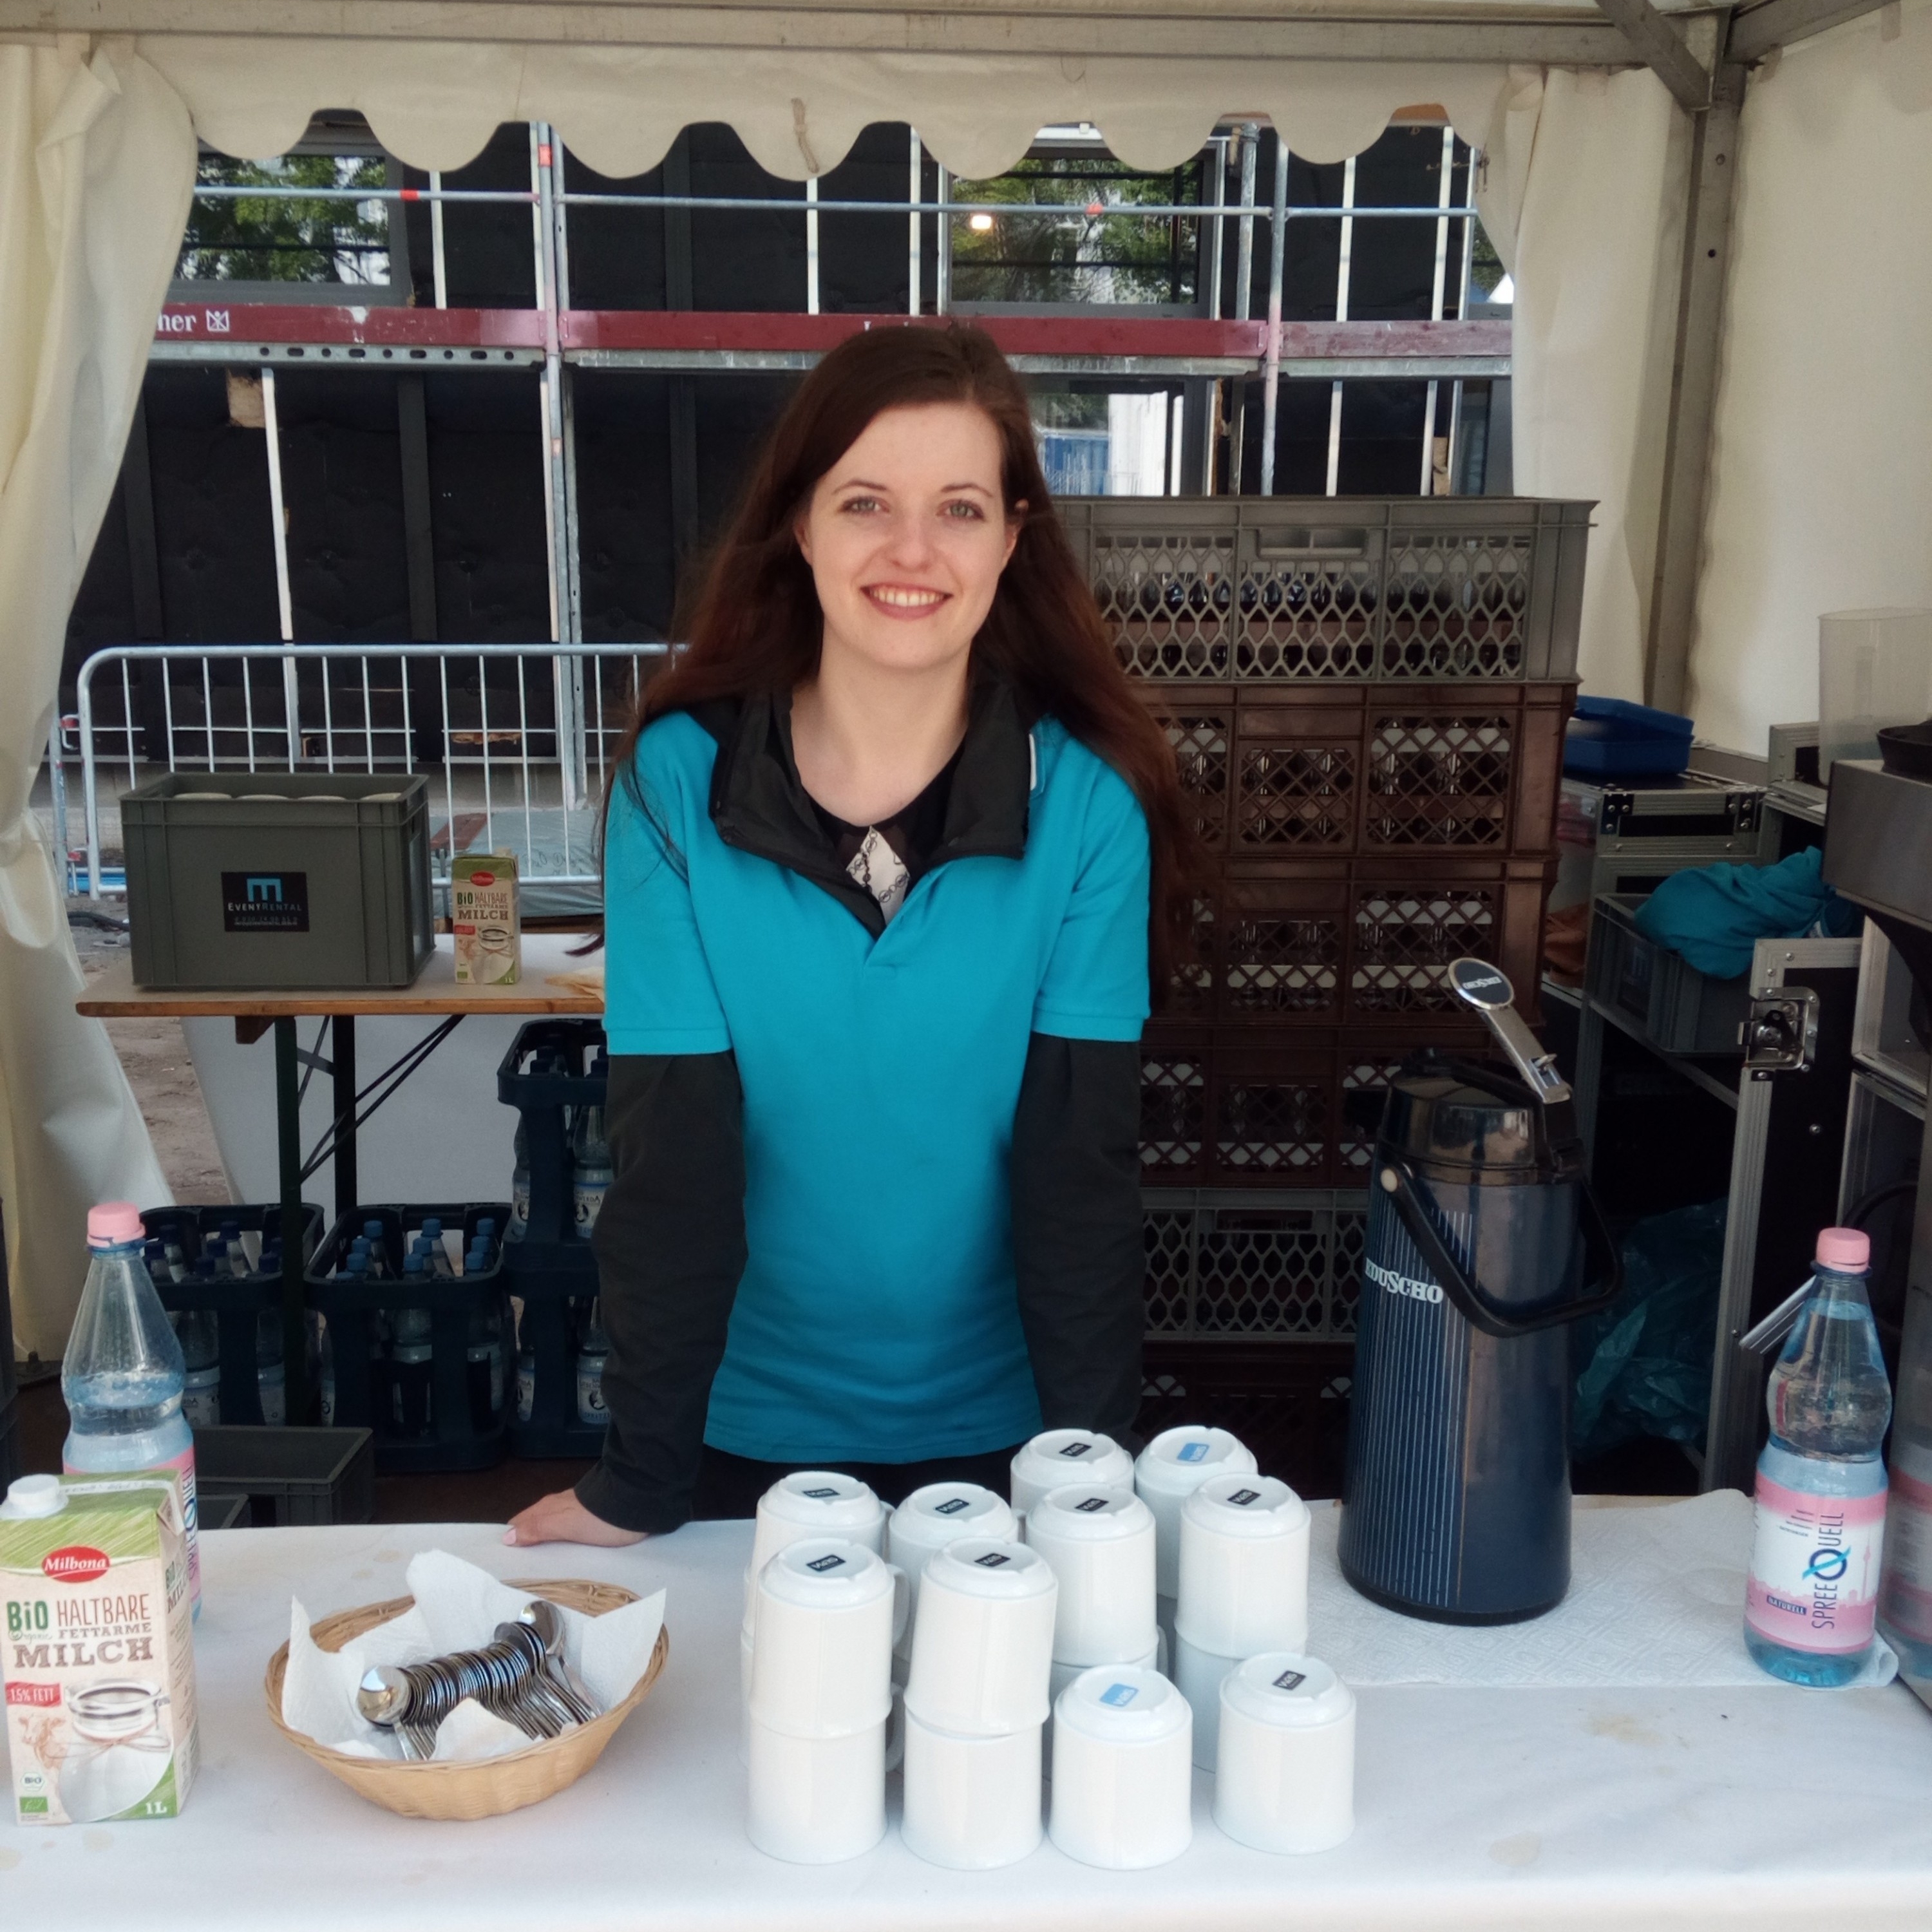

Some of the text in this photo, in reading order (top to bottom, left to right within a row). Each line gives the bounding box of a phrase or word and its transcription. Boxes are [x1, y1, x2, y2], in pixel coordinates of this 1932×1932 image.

[458, 909, 508, 920] MILCH
[44, 1556, 106, 1571] Milbona
[57, 1593, 151, 1627] HALTBARE
[58, 1622, 152, 1639] FETTARME
[13, 1637, 153, 1668] MILCH
[33, 1689, 55, 1702] FETT
[146, 1801, 167, 1815] 1L
